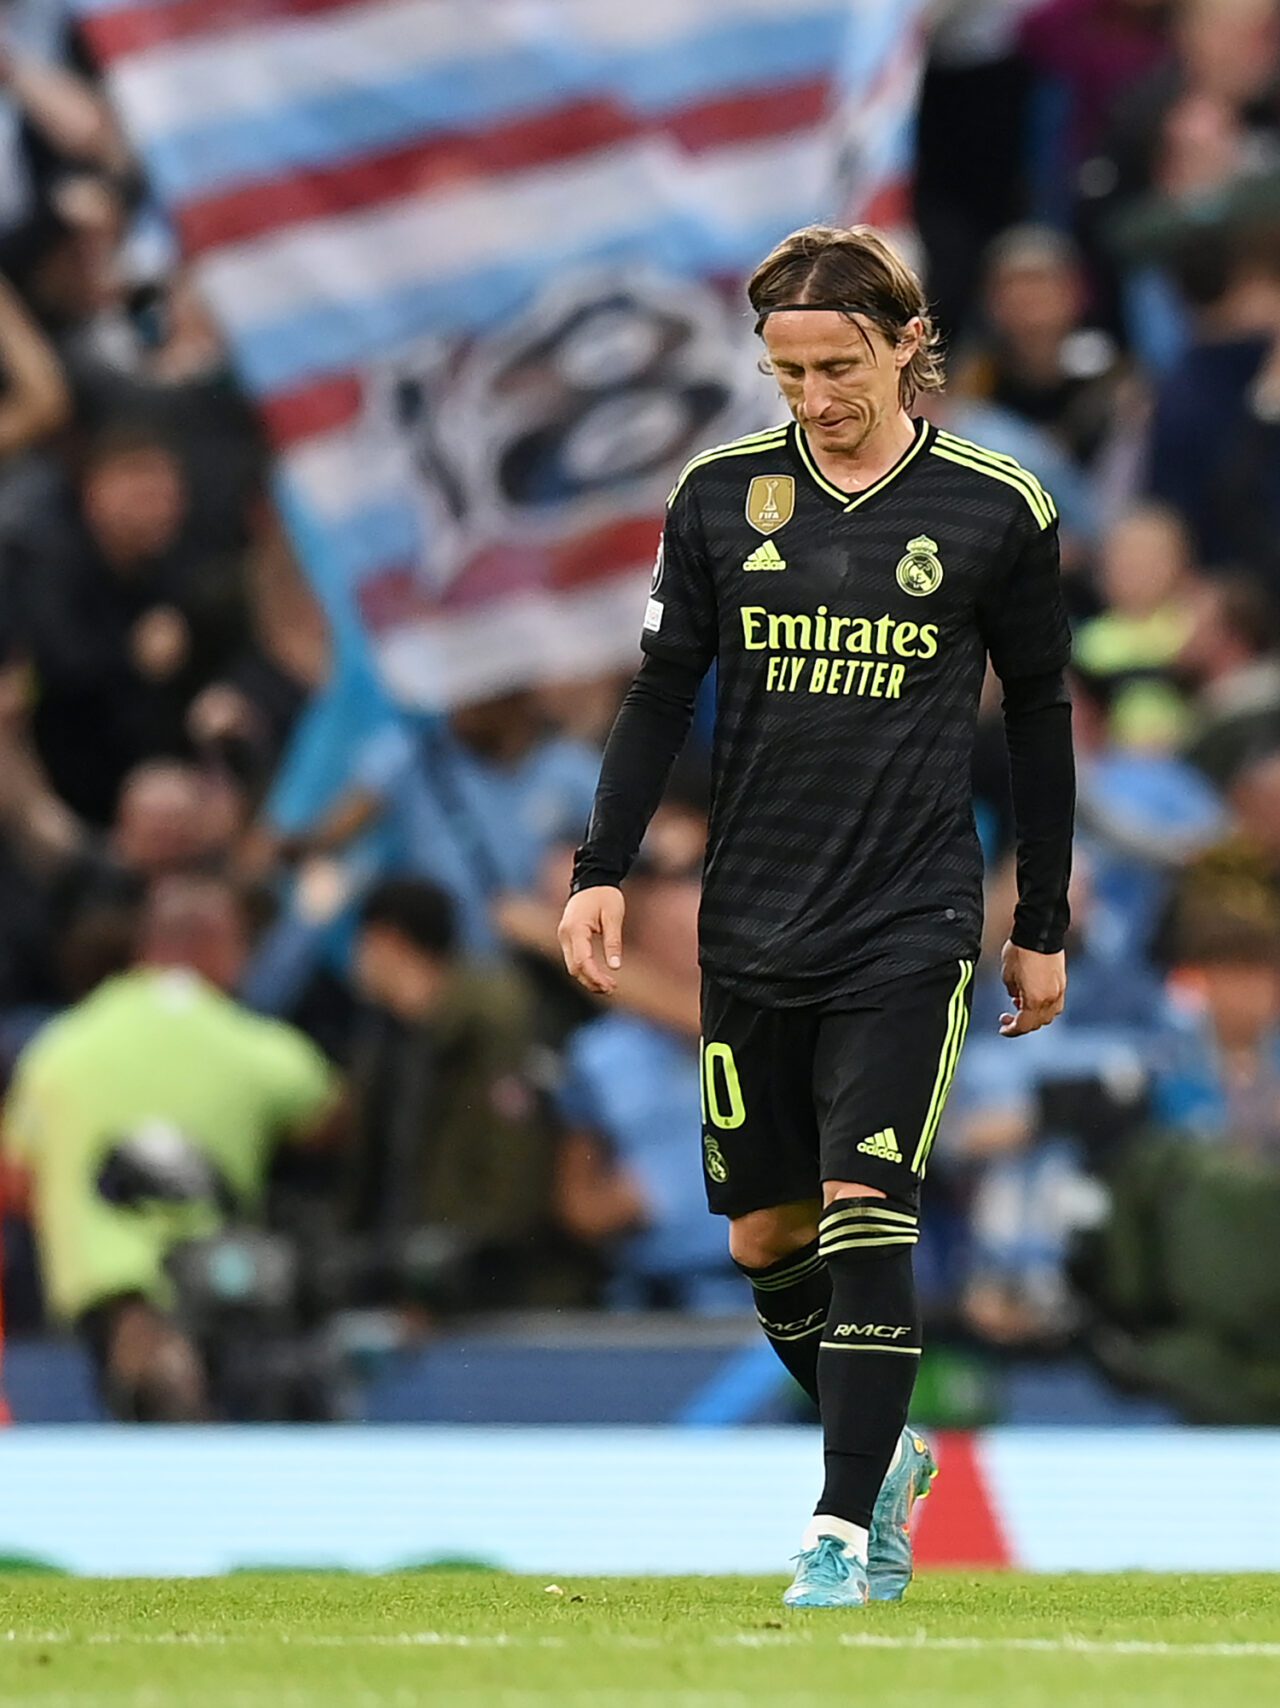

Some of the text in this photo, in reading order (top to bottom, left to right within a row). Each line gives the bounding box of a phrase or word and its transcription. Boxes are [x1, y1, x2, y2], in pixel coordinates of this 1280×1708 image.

[758, 511, 780, 520] FIFA
[743, 558, 786, 572] adidas
[740, 605, 939, 659] Emirates
[766, 656, 906, 699] FLY BETTER
[700, 1036, 746, 1129] 0
[856, 1142, 903, 1164] adidas
[833, 1323, 912, 1339] RMCF
